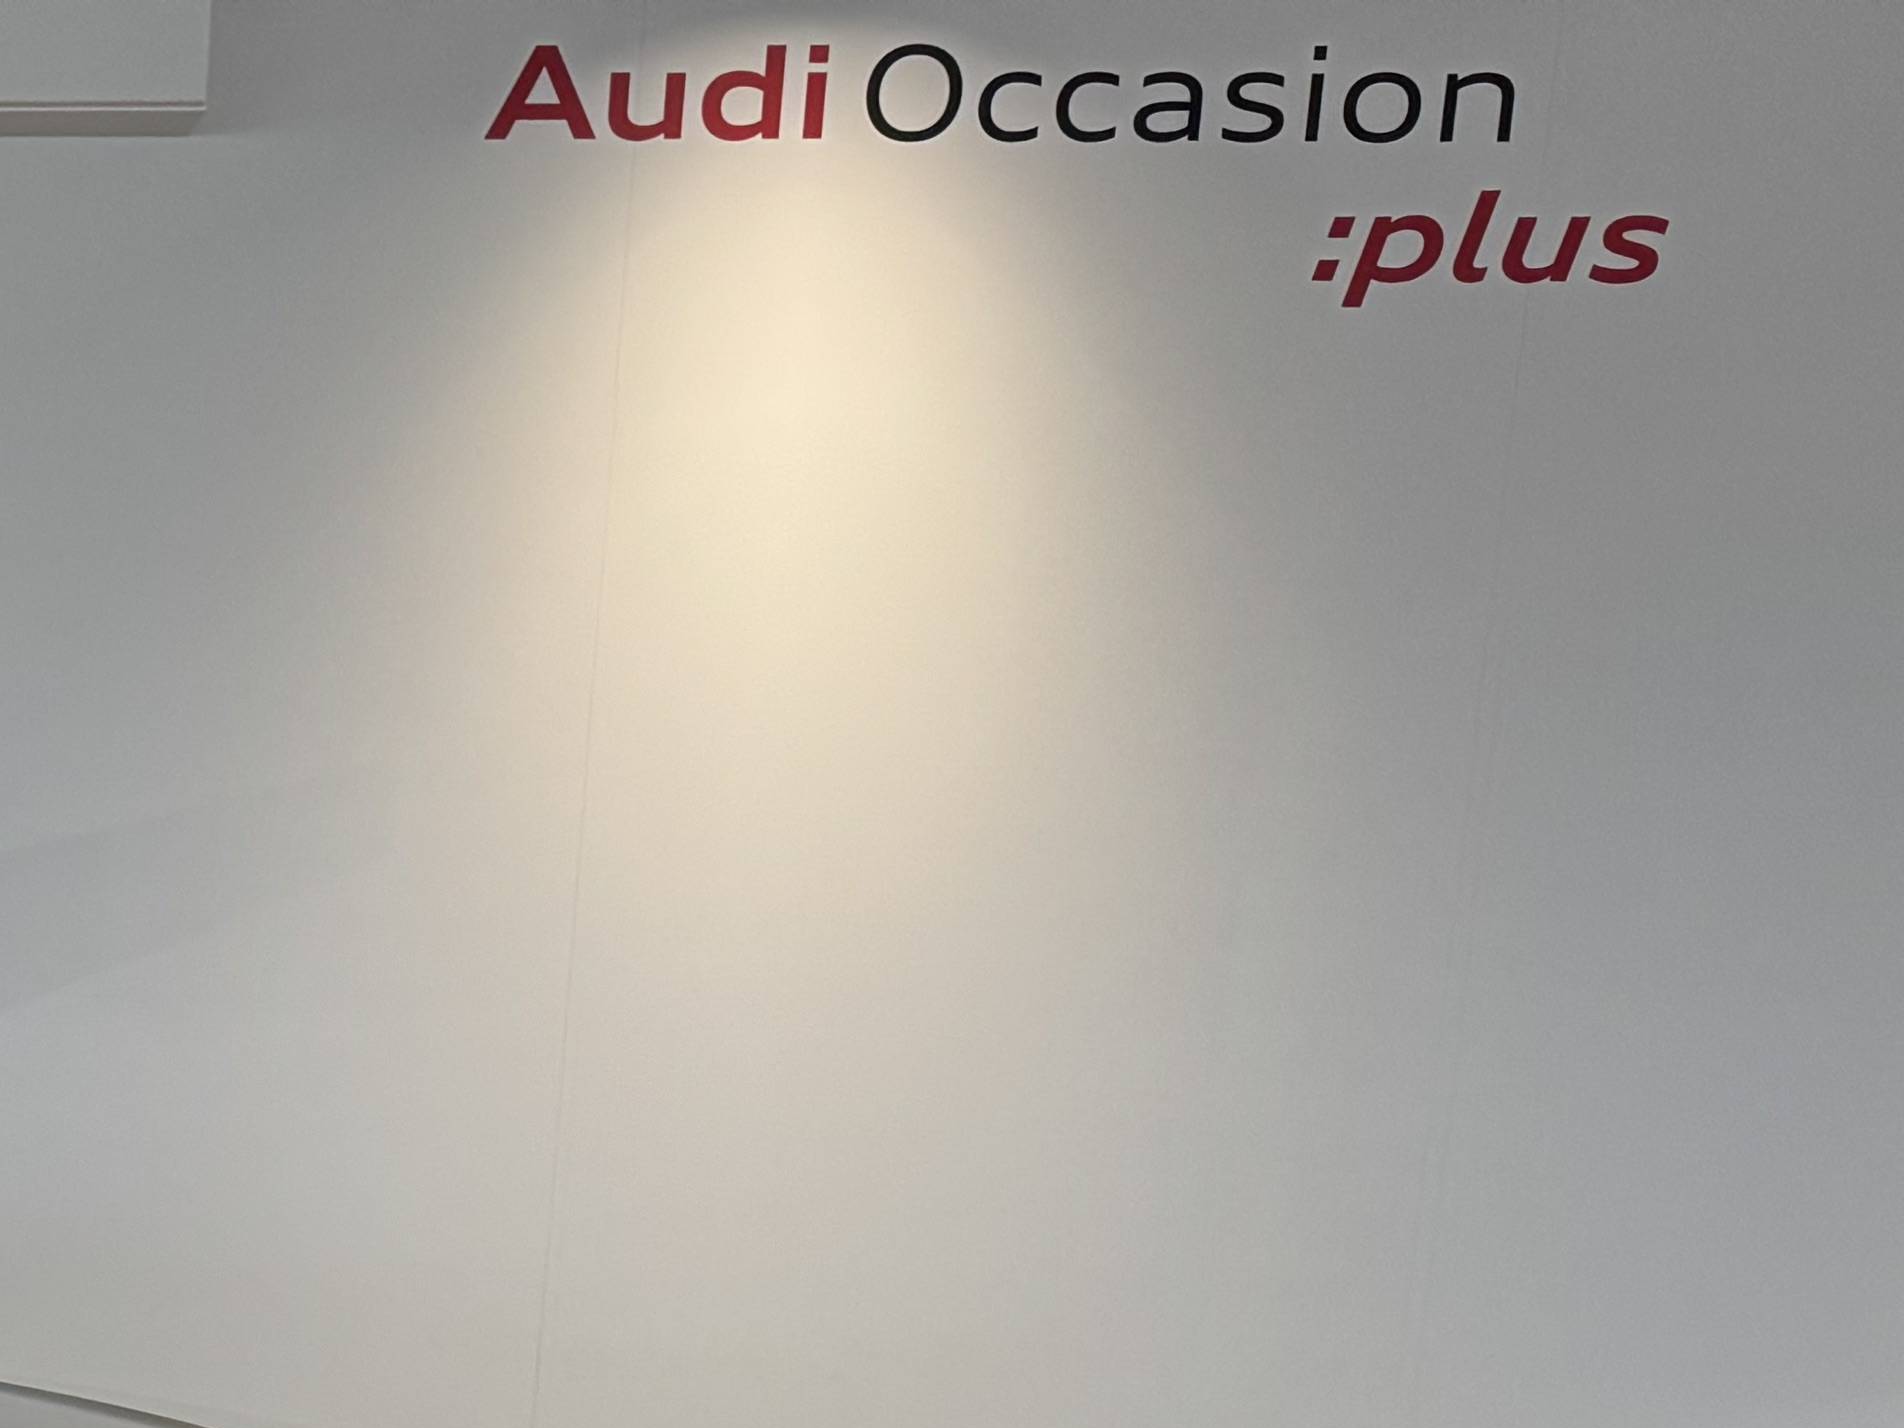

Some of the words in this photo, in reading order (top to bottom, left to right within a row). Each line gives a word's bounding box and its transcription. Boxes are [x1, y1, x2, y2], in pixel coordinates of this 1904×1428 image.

[483, 44, 830, 143] Audi
[864, 43, 1517, 144] Occasion
[1311, 190, 1671, 308] :plus
